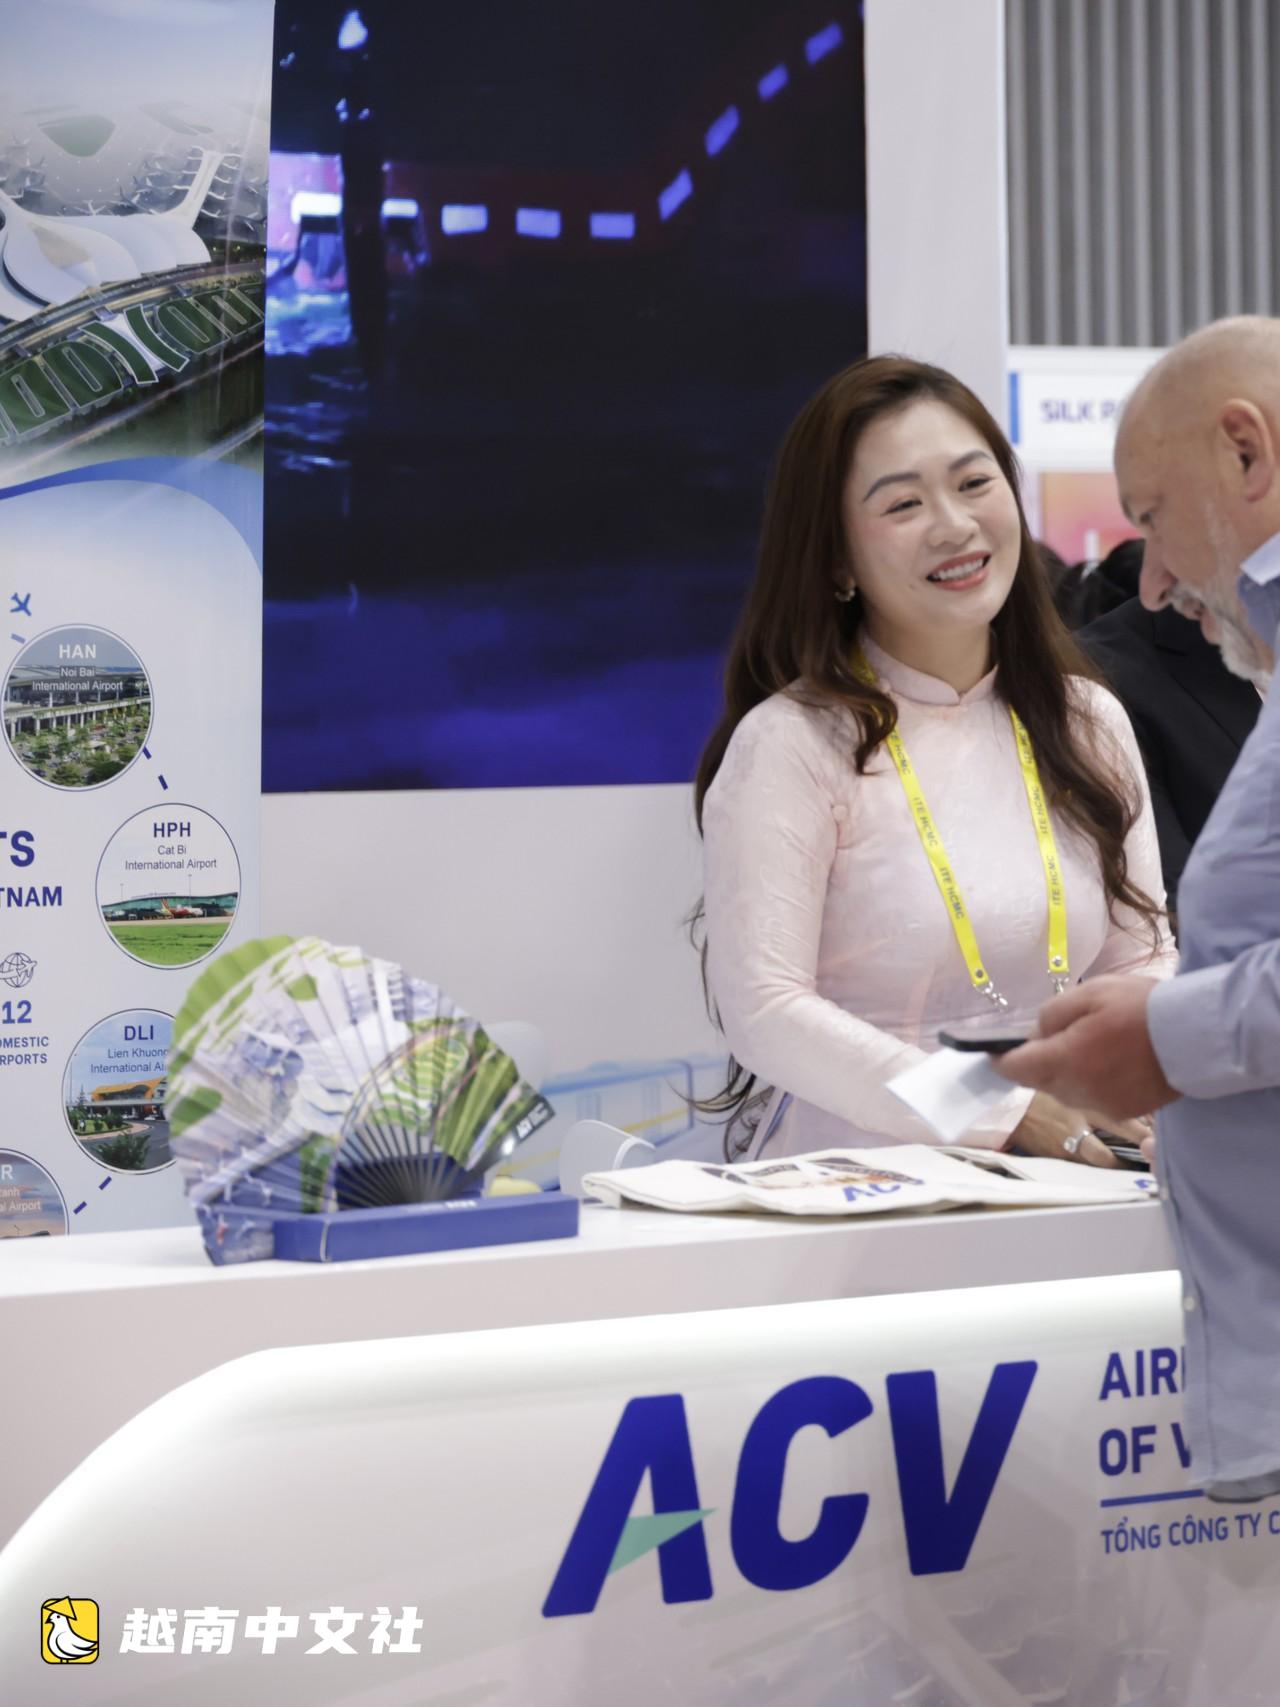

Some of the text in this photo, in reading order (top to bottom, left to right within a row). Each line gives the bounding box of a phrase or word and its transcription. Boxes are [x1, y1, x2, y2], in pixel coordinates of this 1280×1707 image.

[1040, 400, 1094, 422] SILK
[58, 643, 97, 659] HAN
[60, 667, 95, 677] Noi Bai
[32, 680, 124, 692] International Airport
[153, 822, 191, 838] HPH
[919, 815, 938, 848] HCMC
[157, 844, 187, 855] Cat Bi
[125, 858, 217, 871] International Airport
[1047, 854, 1060, 886] HCMC
[939, 866, 965, 920] ITE HCMC
[2, 1000, 32, 1024] 12
[123, 1024, 154, 1041] DLI
[0, 1036, 49, 1049] MESTIC
[107, 1048, 129, 1059] Lien
[90, 1062, 152, 1074] International
[9, 1200, 42, 1213] Airport
[1099, 1424, 1157, 1477] OF
[541, 1360, 1039, 1618] ACV
[1101, 1515, 1161, 1554] TỔNG
[1168, 1513, 1229, 1547] CÔNG
[1234, 1512, 1262, 1539] TY
